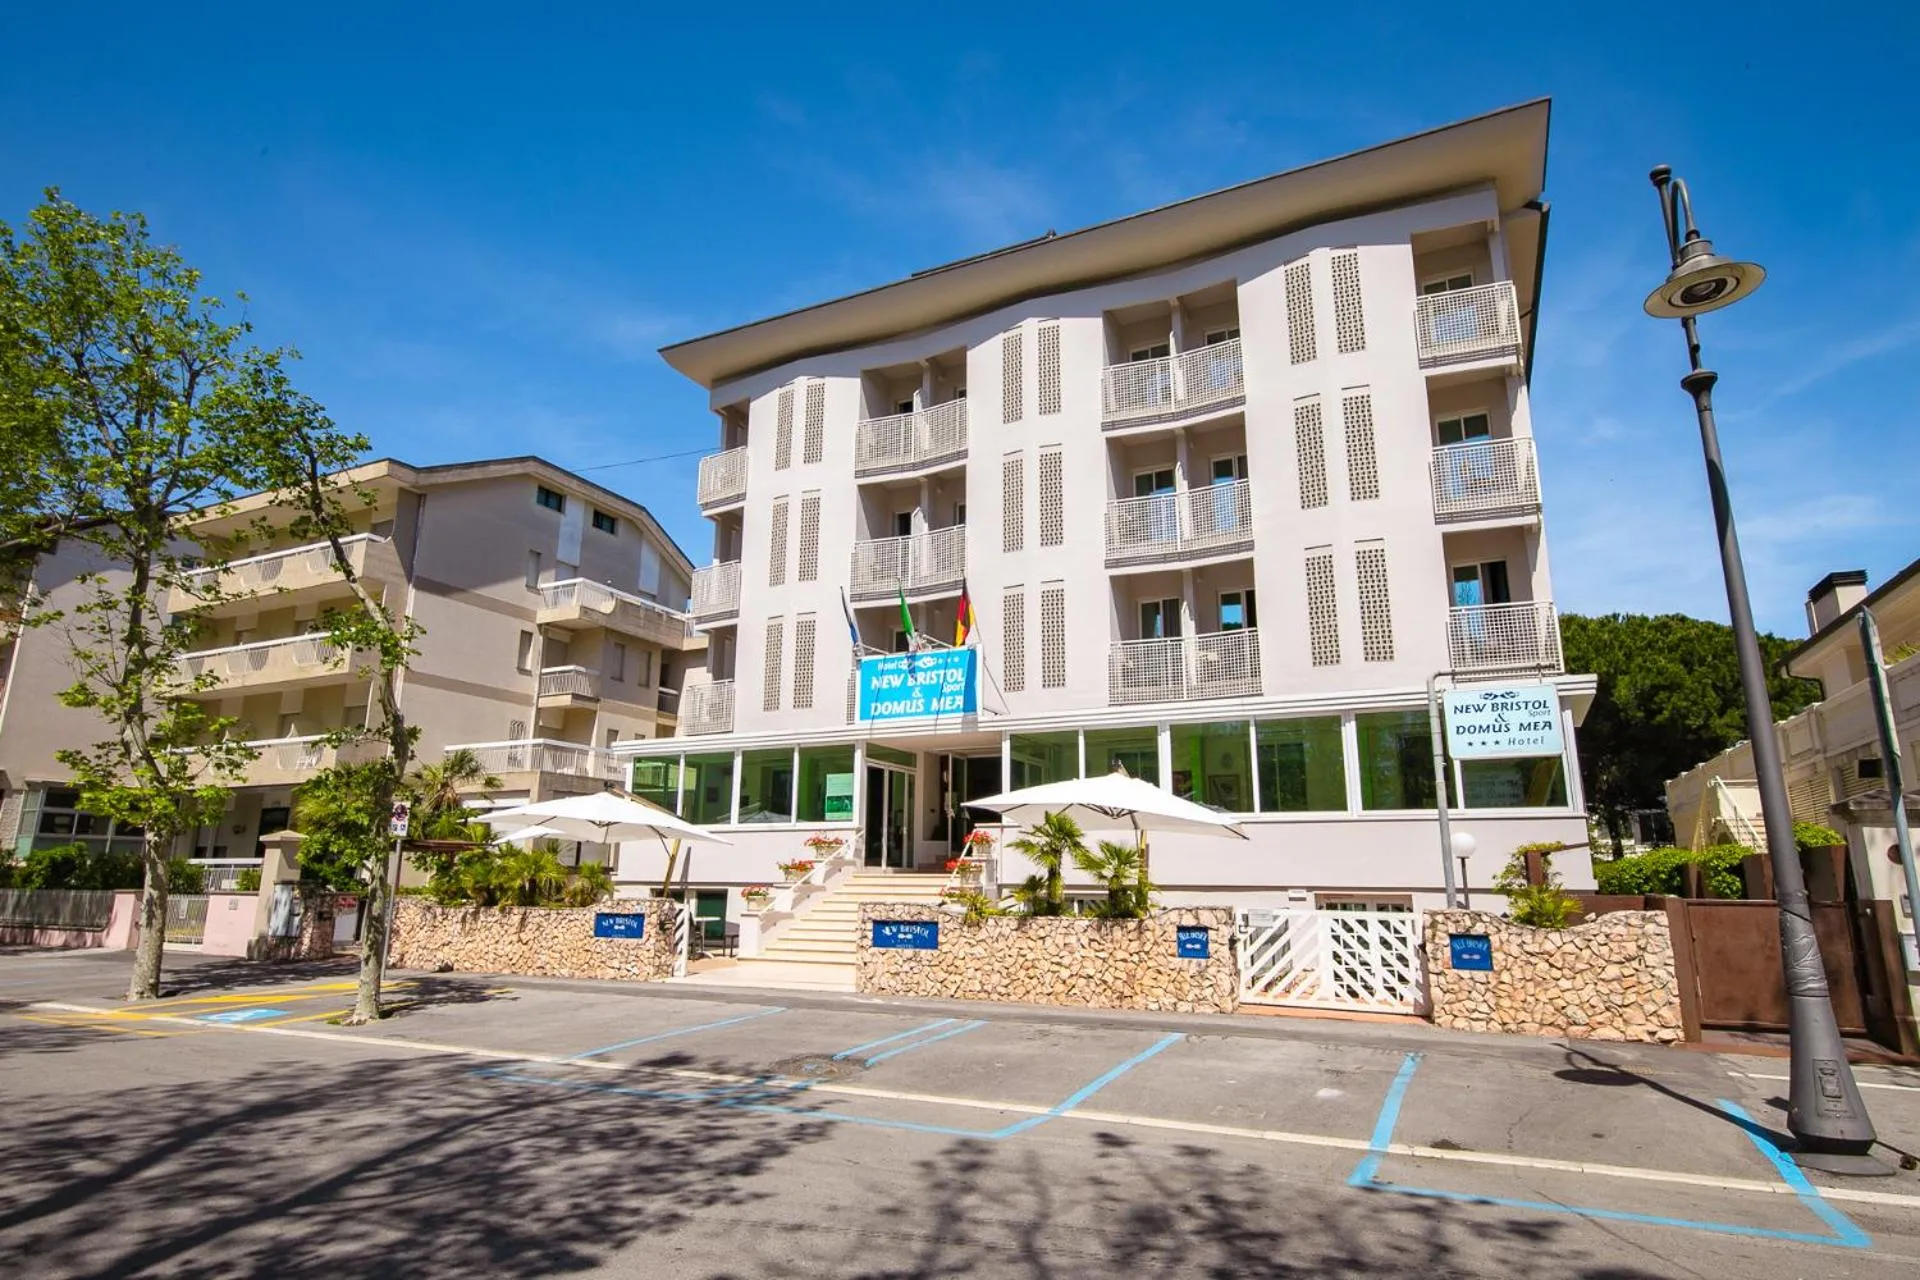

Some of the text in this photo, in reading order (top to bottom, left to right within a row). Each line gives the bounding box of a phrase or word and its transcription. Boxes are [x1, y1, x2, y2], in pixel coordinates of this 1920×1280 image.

[871, 668, 965, 690] NEW BRISTOL
[912, 687, 922, 698] &
[870, 695, 964, 716] DOMUS MEA
[1453, 700, 1550, 715] NEW BRISTOL
[1494, 712, 1508, 723] &
[1528, 709, 1551, 718] Sport
[1455, 721, 1553, 735] DOMUS MEA
[1507, 735, 1545, 746] Hotel
